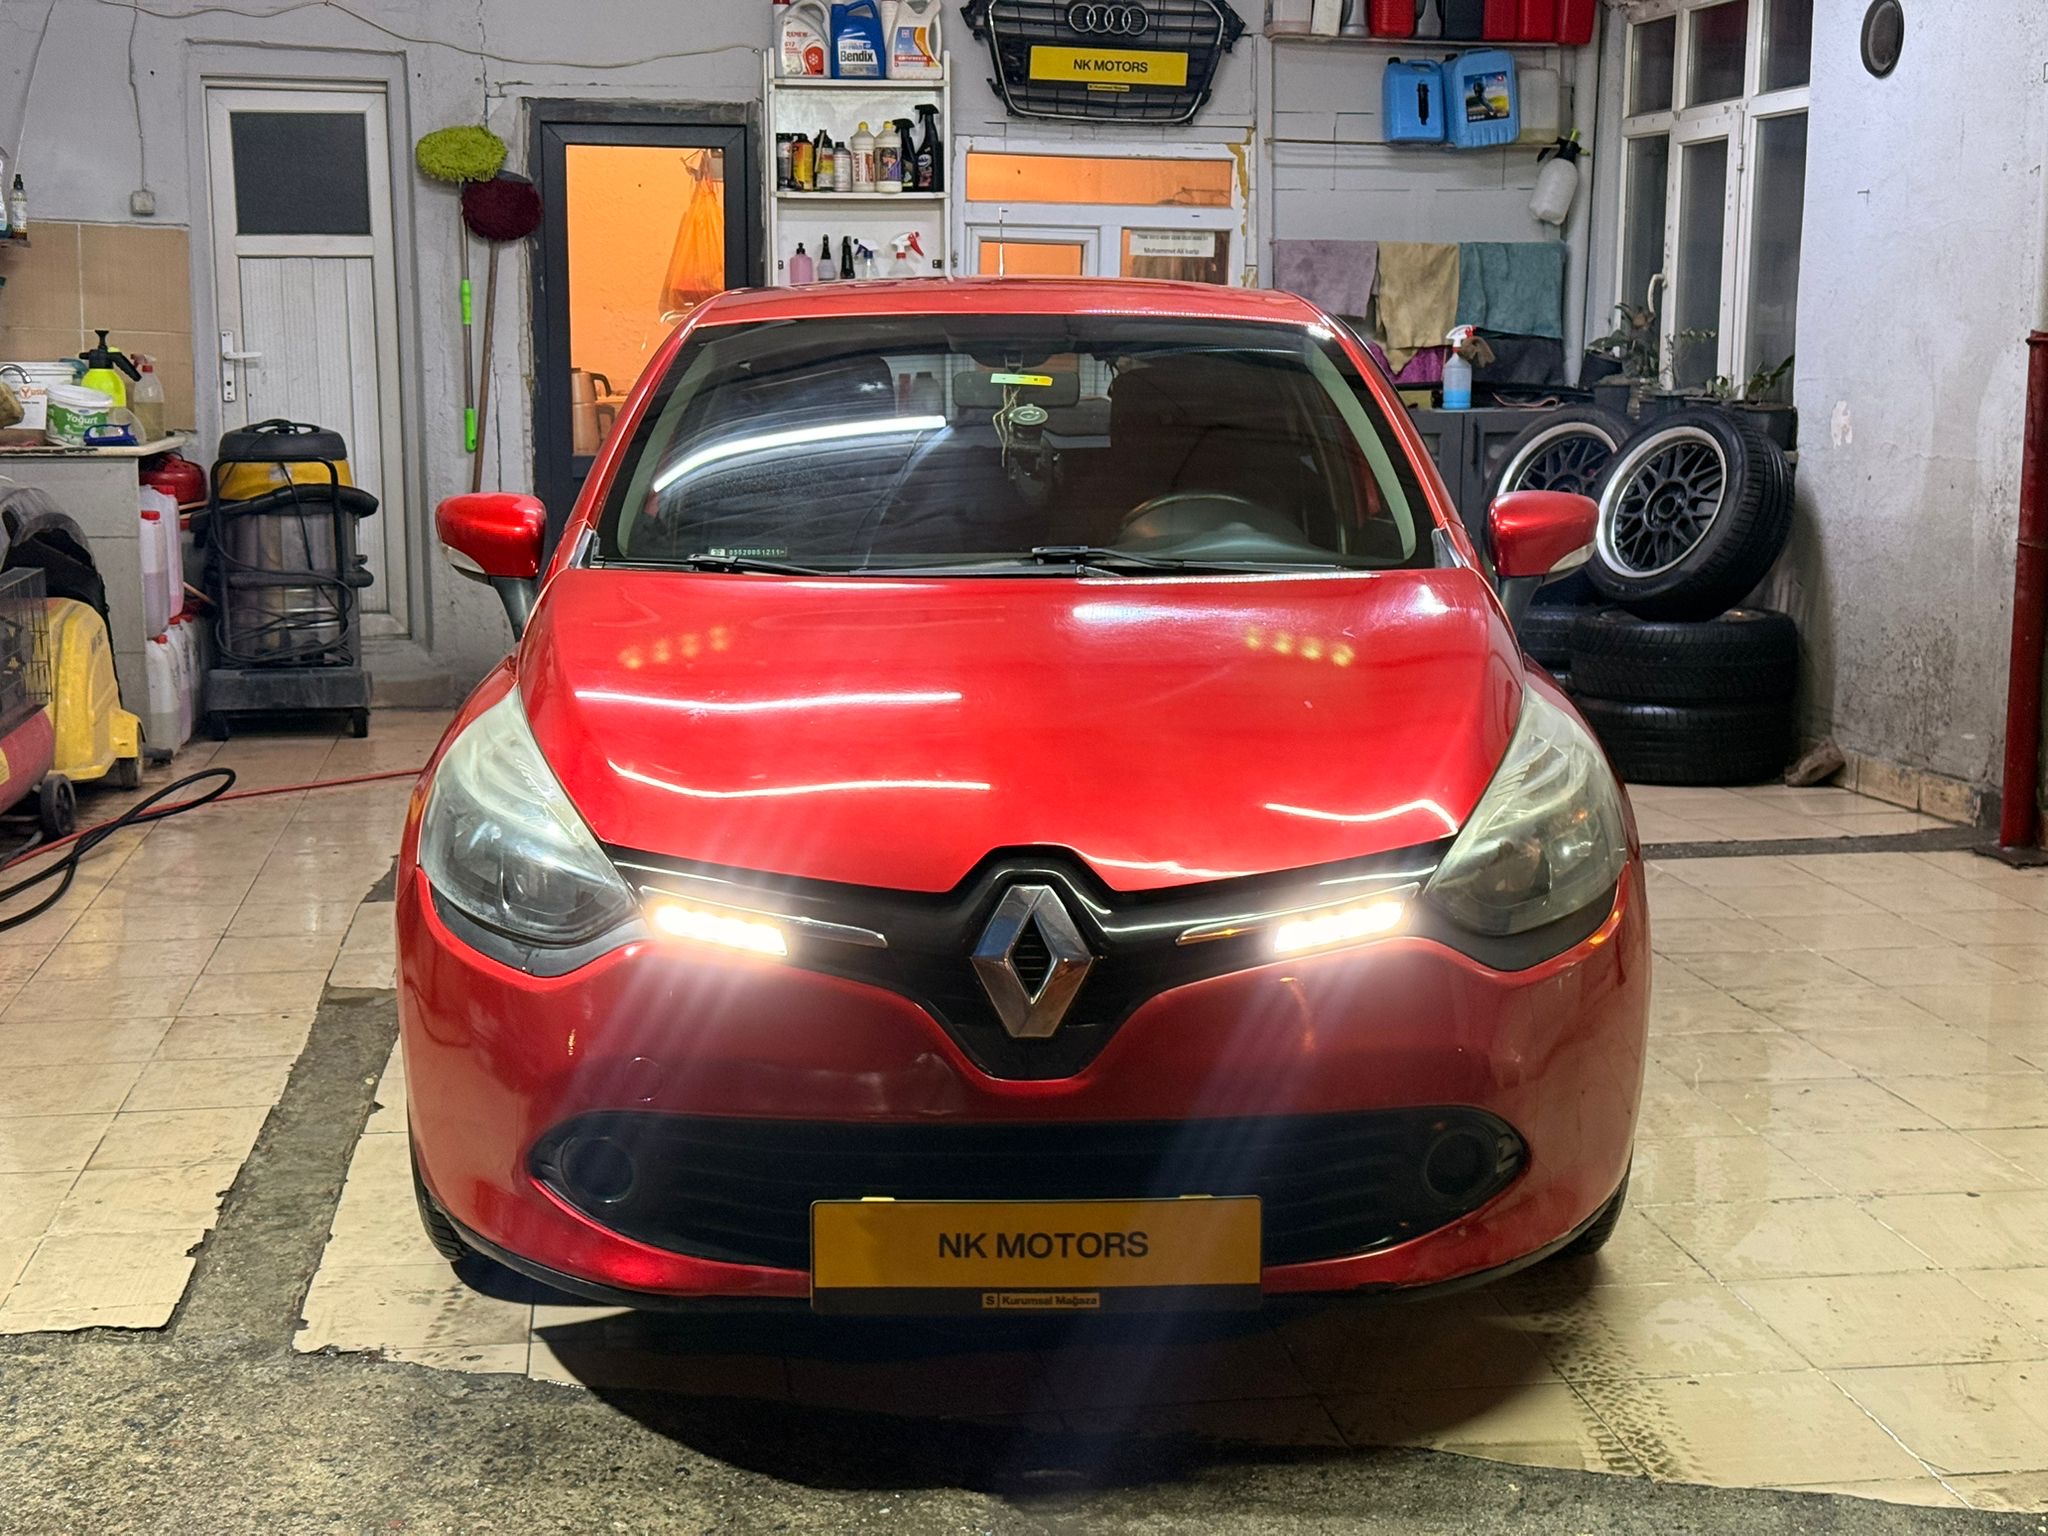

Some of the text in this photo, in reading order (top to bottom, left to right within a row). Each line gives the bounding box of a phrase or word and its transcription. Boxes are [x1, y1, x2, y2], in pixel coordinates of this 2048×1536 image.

[840, 50, 873, 62] Bendix
[1073, 58, 1148, 73] NK MOTORS
[938, 1231, 1149, 1259] NK MOTORS
[985, 1295, 1097, 1307] S Kurumsal Mağaza
